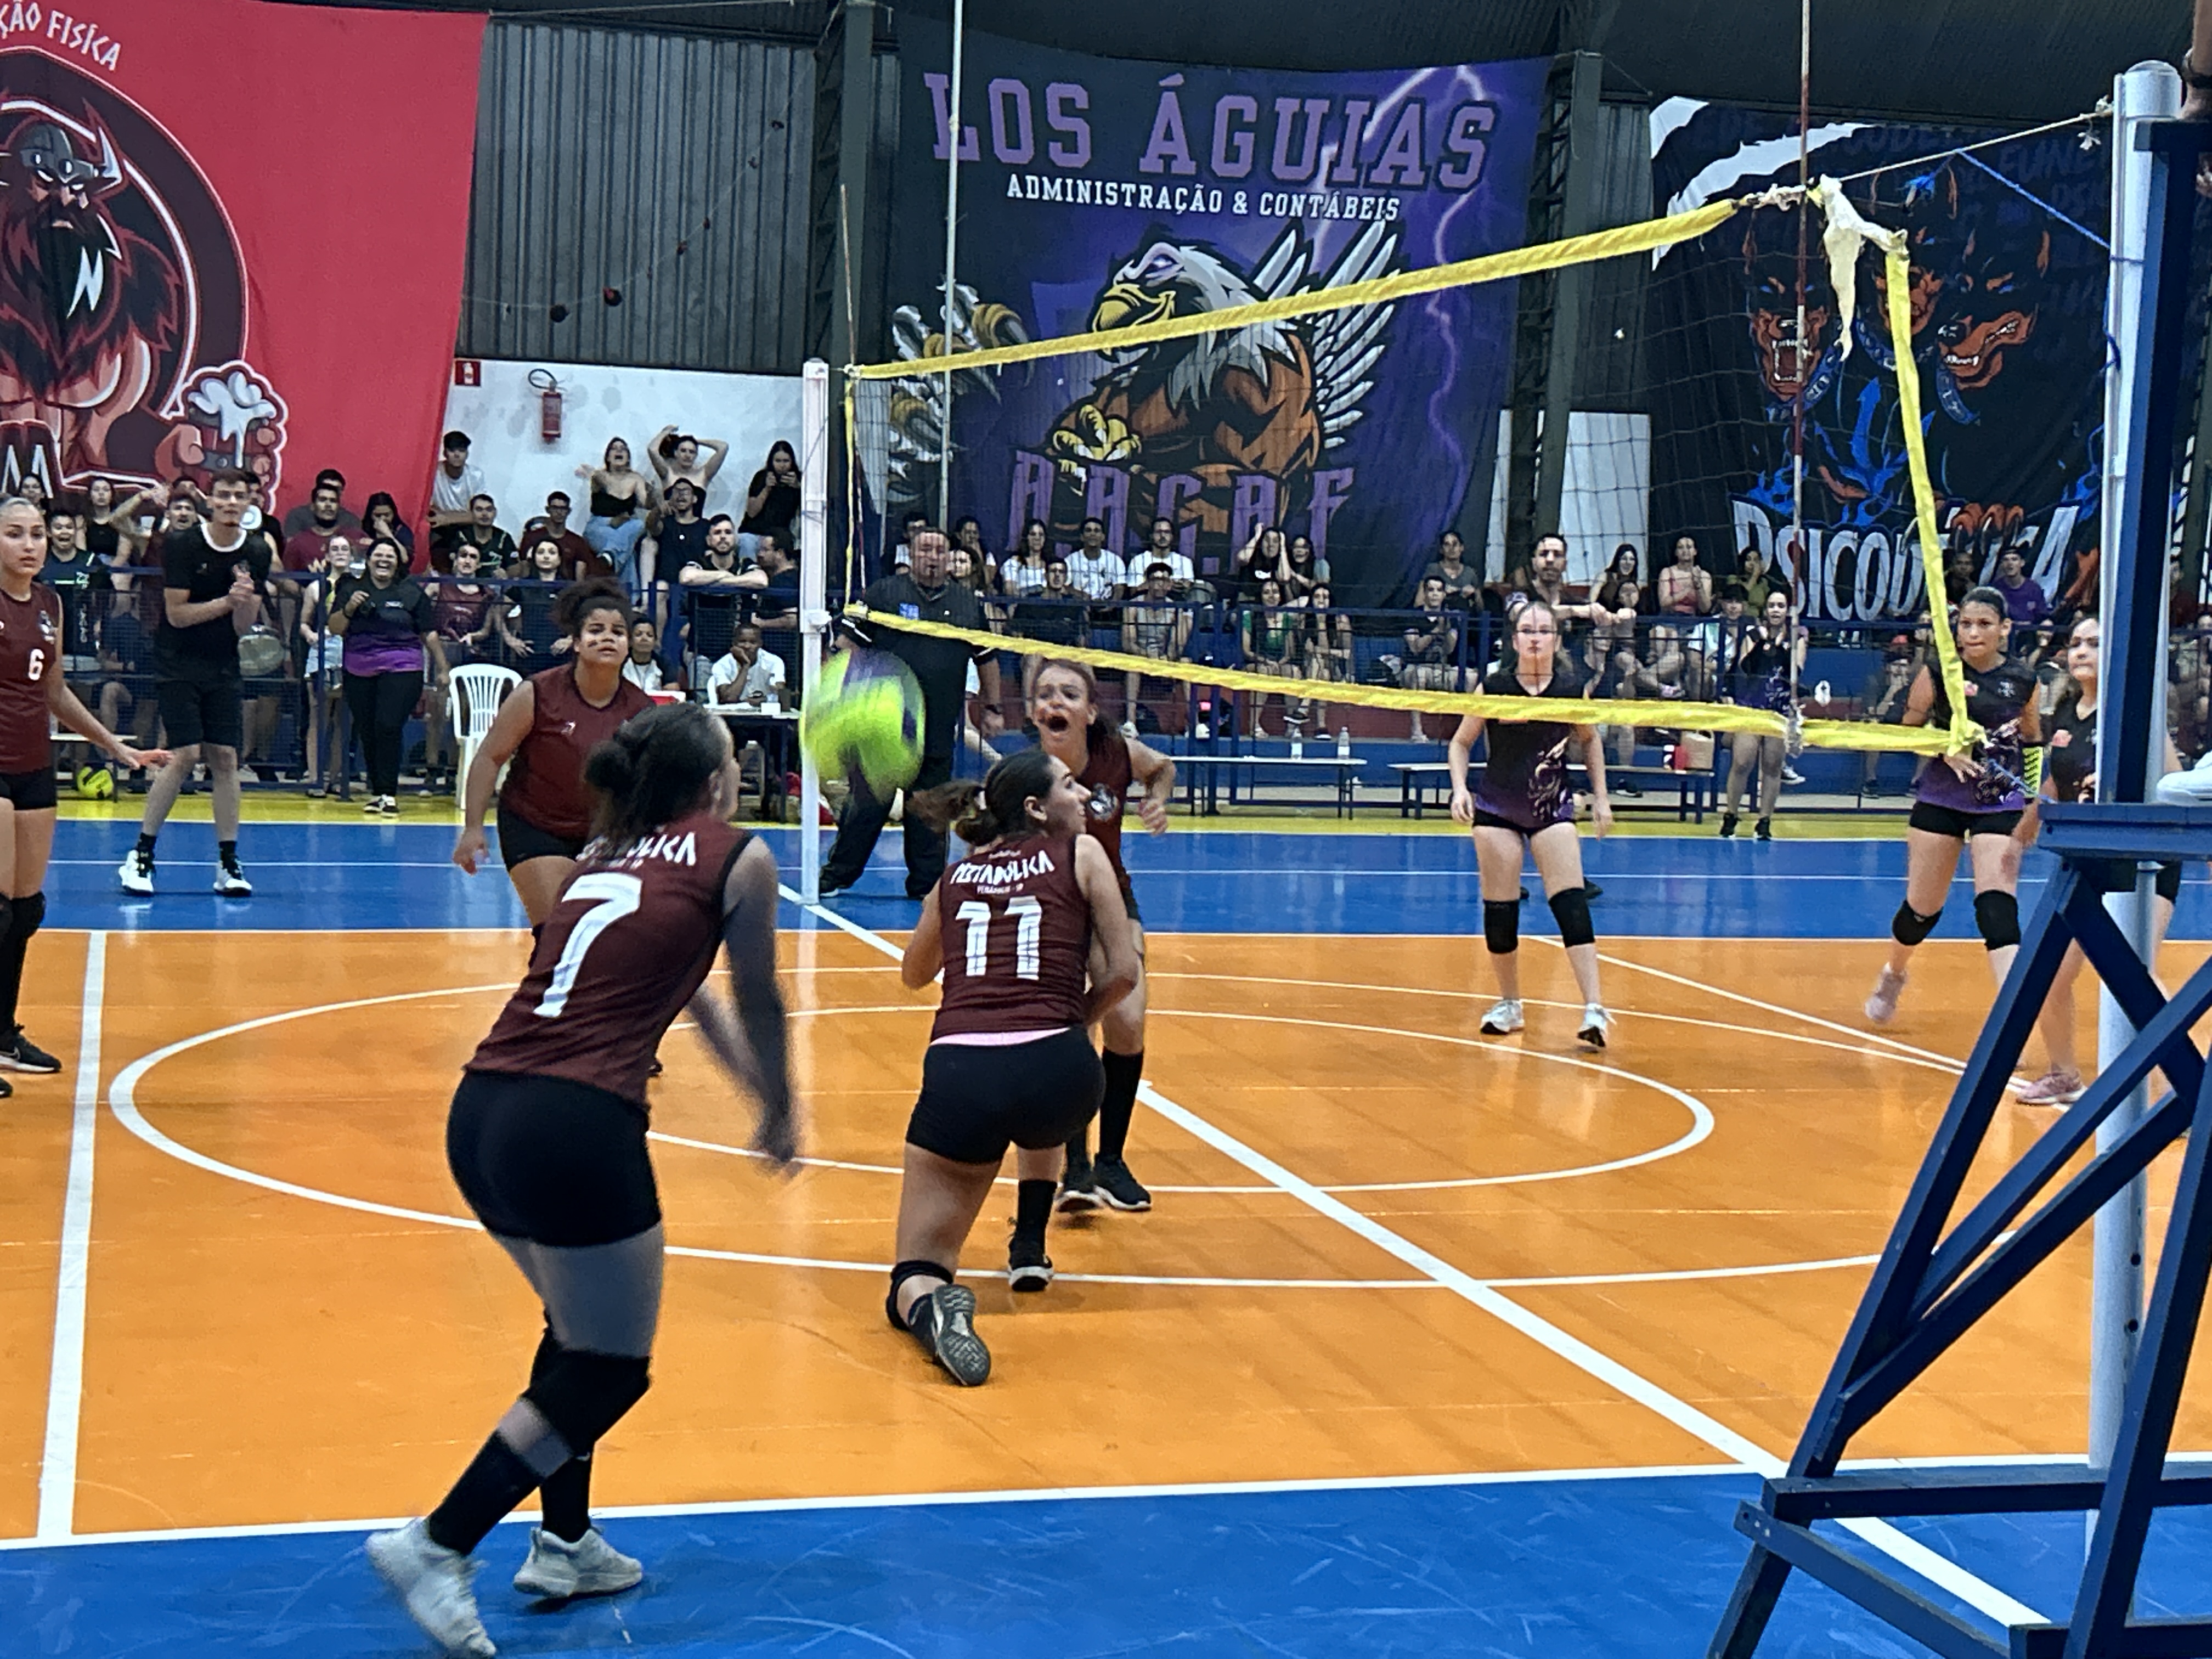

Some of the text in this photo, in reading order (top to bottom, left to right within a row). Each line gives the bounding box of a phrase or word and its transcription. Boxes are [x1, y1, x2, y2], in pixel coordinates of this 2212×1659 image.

[923, 72, 1497, 189] LOS ÁGUIAS
[1007, 173, 1400, 221] ADMINISTRAÇÃO & CONTÁBEIS
[29, 648, 45, 681] 6
[533, 871, 643, 1018] 7
[955, 895, 1042, 980] 11
